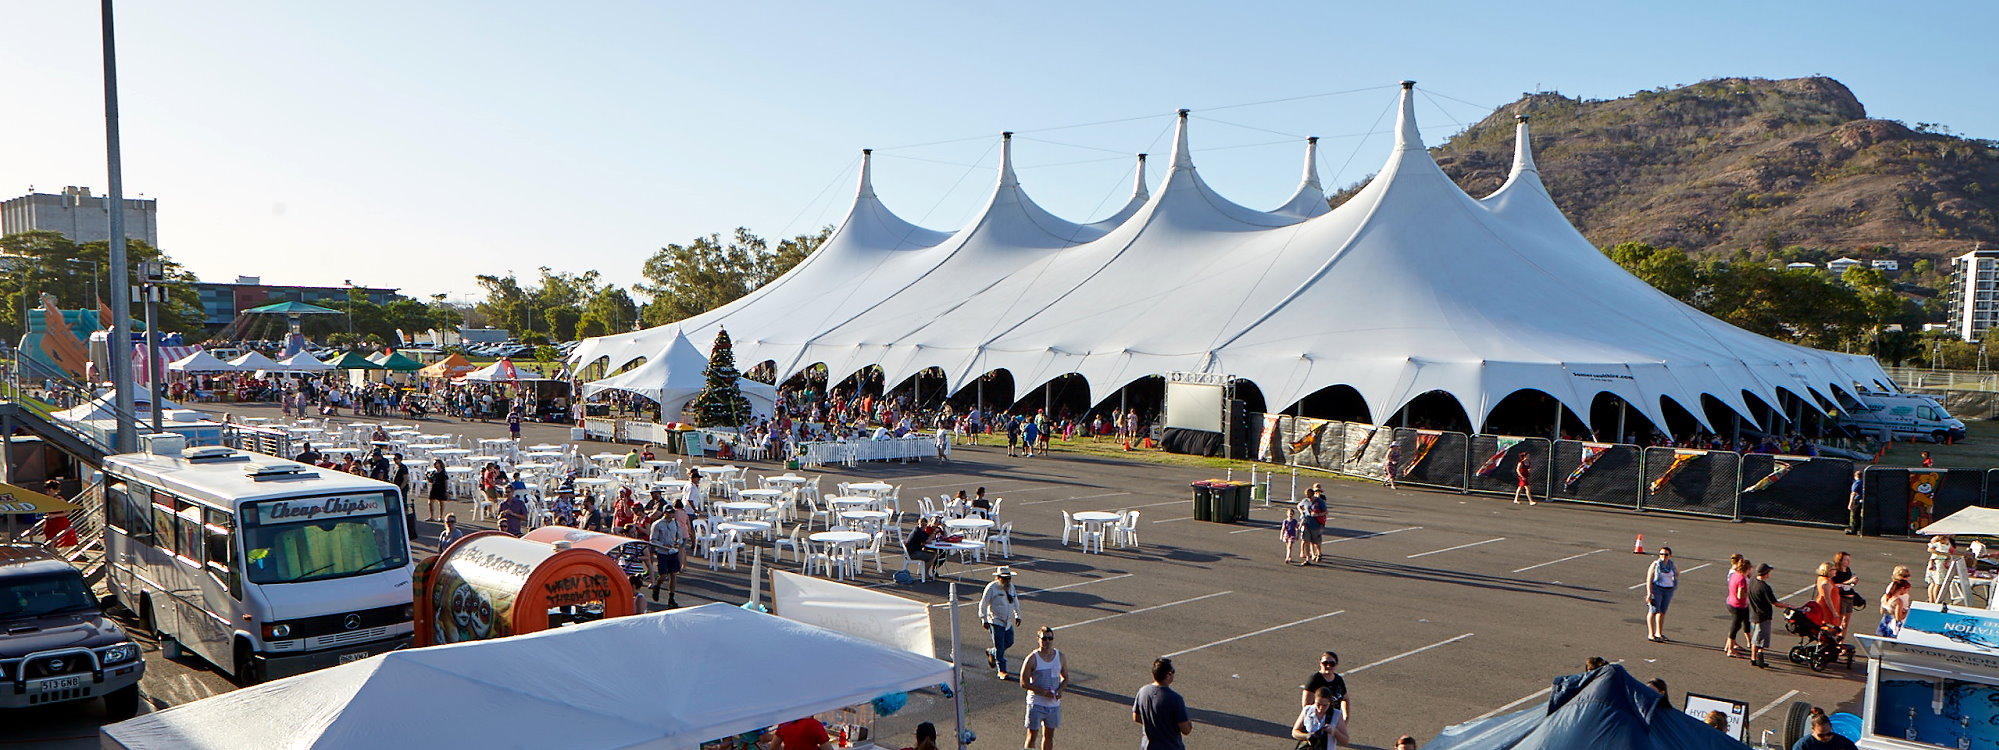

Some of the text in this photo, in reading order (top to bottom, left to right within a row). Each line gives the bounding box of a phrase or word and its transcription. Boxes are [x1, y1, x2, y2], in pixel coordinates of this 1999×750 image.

[270, 502, 322, 519] Cheap
[321, 498, 367, 515] Chips
[544, 574, 609, 594] WHEN LIFE
